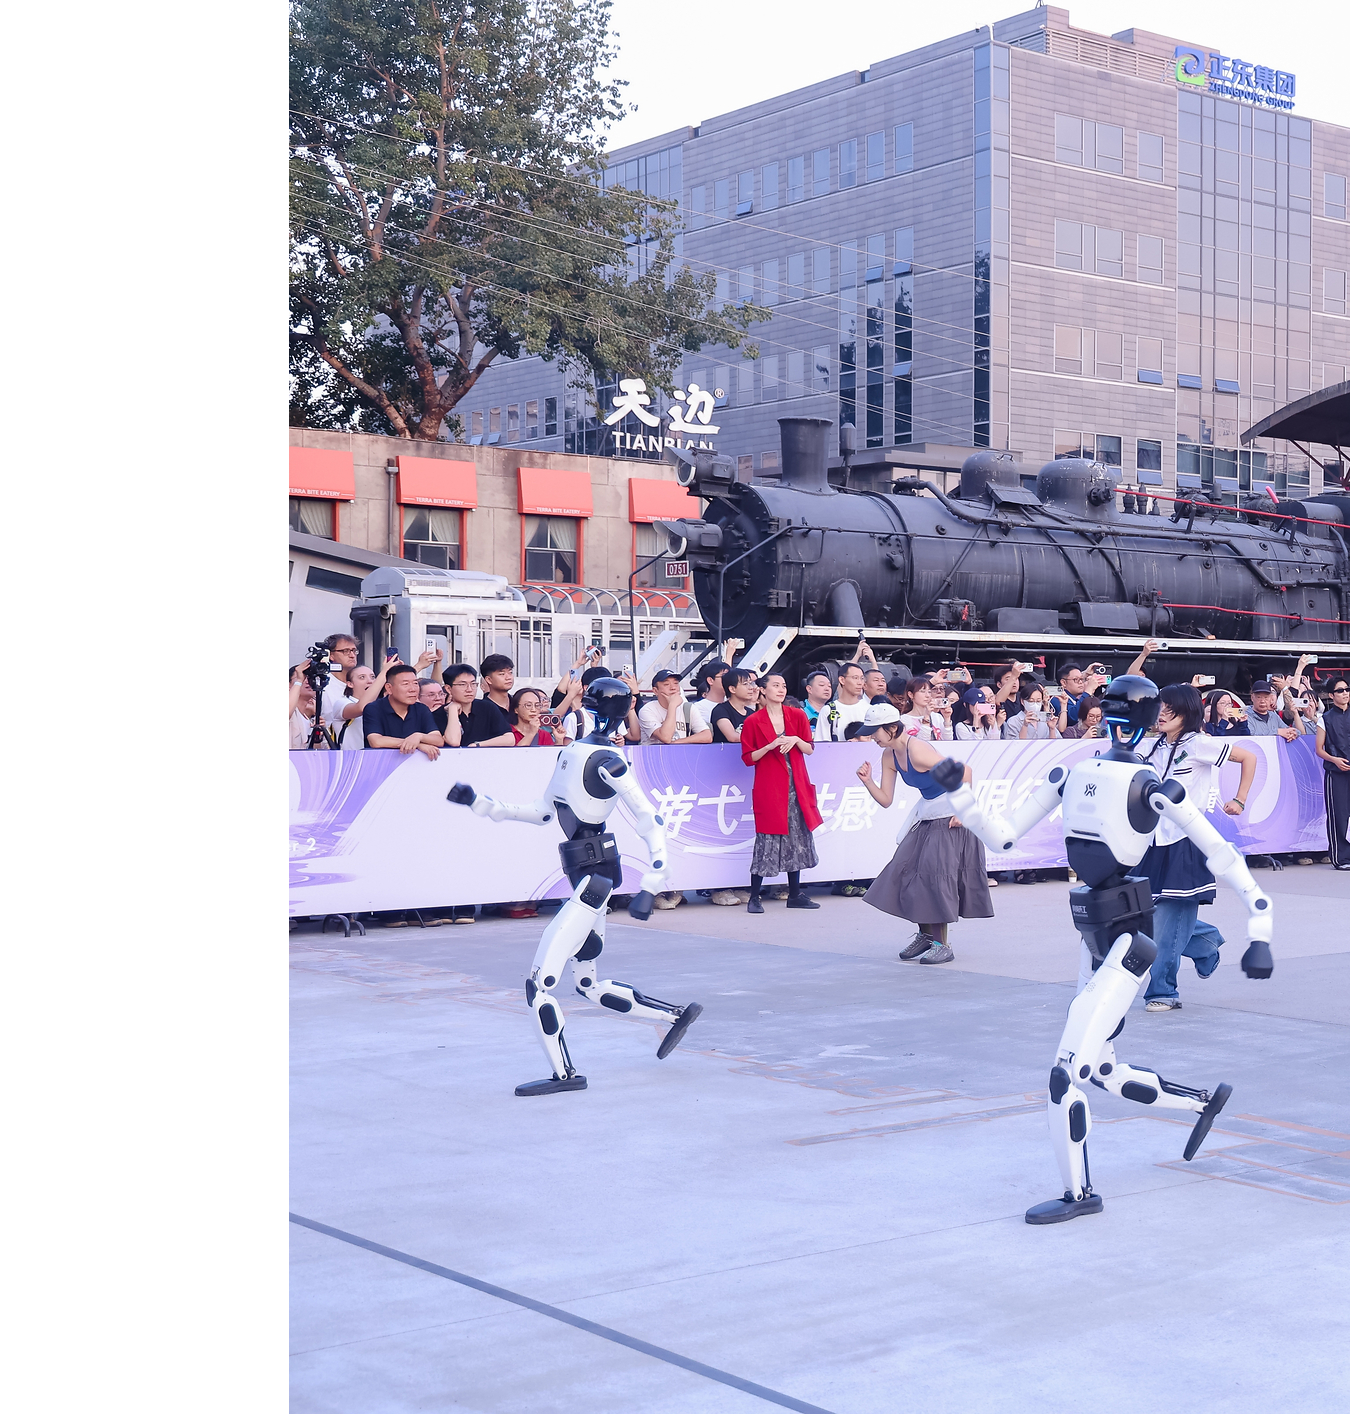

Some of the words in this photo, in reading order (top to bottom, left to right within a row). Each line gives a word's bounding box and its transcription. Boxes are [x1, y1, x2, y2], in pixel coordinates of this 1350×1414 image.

[1208, 52, 1296, 97] 正东集团
[1208, 81, 1264, 103] ZHENGDONG
[1265, 96, 1296, 110] GROUP
[603, 378, 721, 434] 天边
[307, 488, 319, 496] BITE
[320, 489, 341, 497] EATERY
[415, 496, 432, 504] TERRA
[433, 497, 445, 505] BITE
[445, 498, 464, 506] EATERY
[668, 563, 688, 576] 0751
